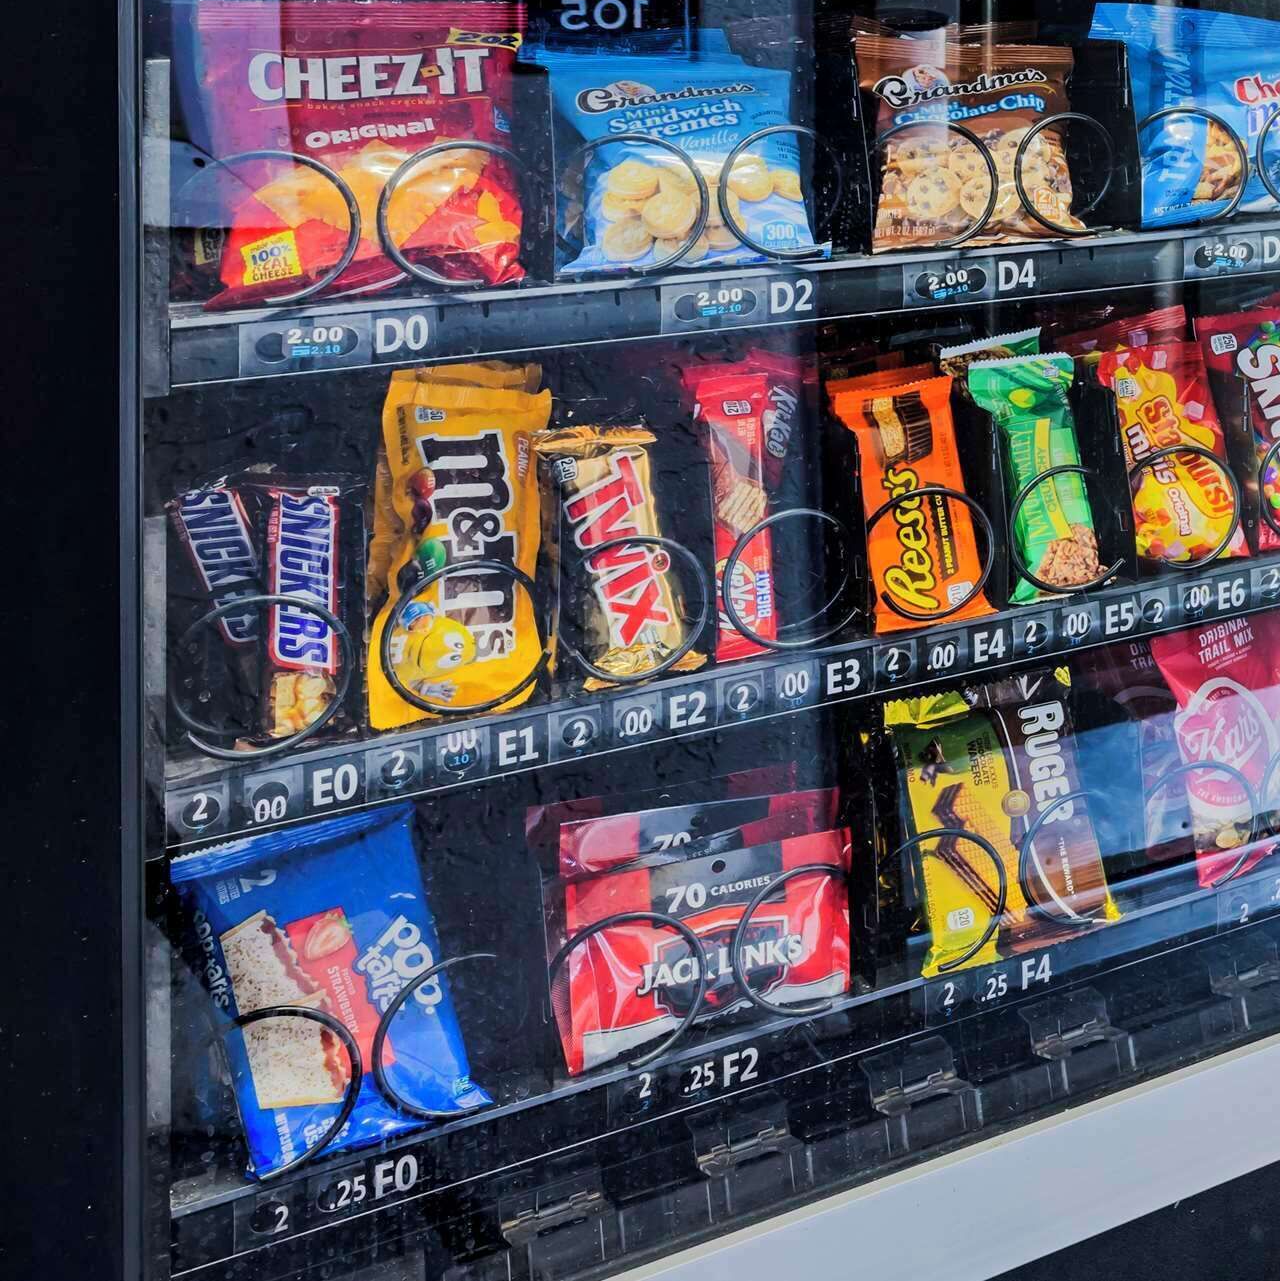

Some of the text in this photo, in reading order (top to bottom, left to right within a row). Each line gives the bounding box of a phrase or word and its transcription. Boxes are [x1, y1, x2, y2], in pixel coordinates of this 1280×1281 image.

[577, 82, 754, 112] Grandma's
[872, 69, 1047, 109] Grandma's
[1000, 94, 1045, 111] Chip
[609, 100, 742, 134] Sandwich
[625, 106, 669, 121] Mini
[766, 224, 794, 240] 300
[999, 259, 1036, 291] D4
[770, 279, 813, 314] D2
[376, 315, 428, 354] D0
[1222, 334, 1235, 349] 250
[1168, 488, 1191, 536] Original
[883, 466, 940, 610] Reese's
[935, 507, 953, 567] PEANUT BUTTER
[1218, 578, 1246, 610] E6
[1104, 597, 1135, 634] E5
[1199, 618, 1250, 648] ORIGINAL
[974, 628, 1005, 663] E4
[1199, 628, 1254, 664] TRAIL MIX
[826, 659, 860, 694] E3
[670, 692, 707, 729] E2
[499, 726, 539, 766] E1
[966, 740, 983, 786] WAFERS
[1018, 700, 1073, 825] RUGER
[313, 764, 357, 806] E0
[240, 868, 277, 894] 2
[666, 876, 770, 913] 70 CALORIES
[958, 909, 970, 927] 320
[1021, 954, 1052, 990] F4
[326, 966, 361, 1034] STRAWBERRY
[723, 1047, 759, 1088] F2
[375, 1155, 418, 1199] F0
